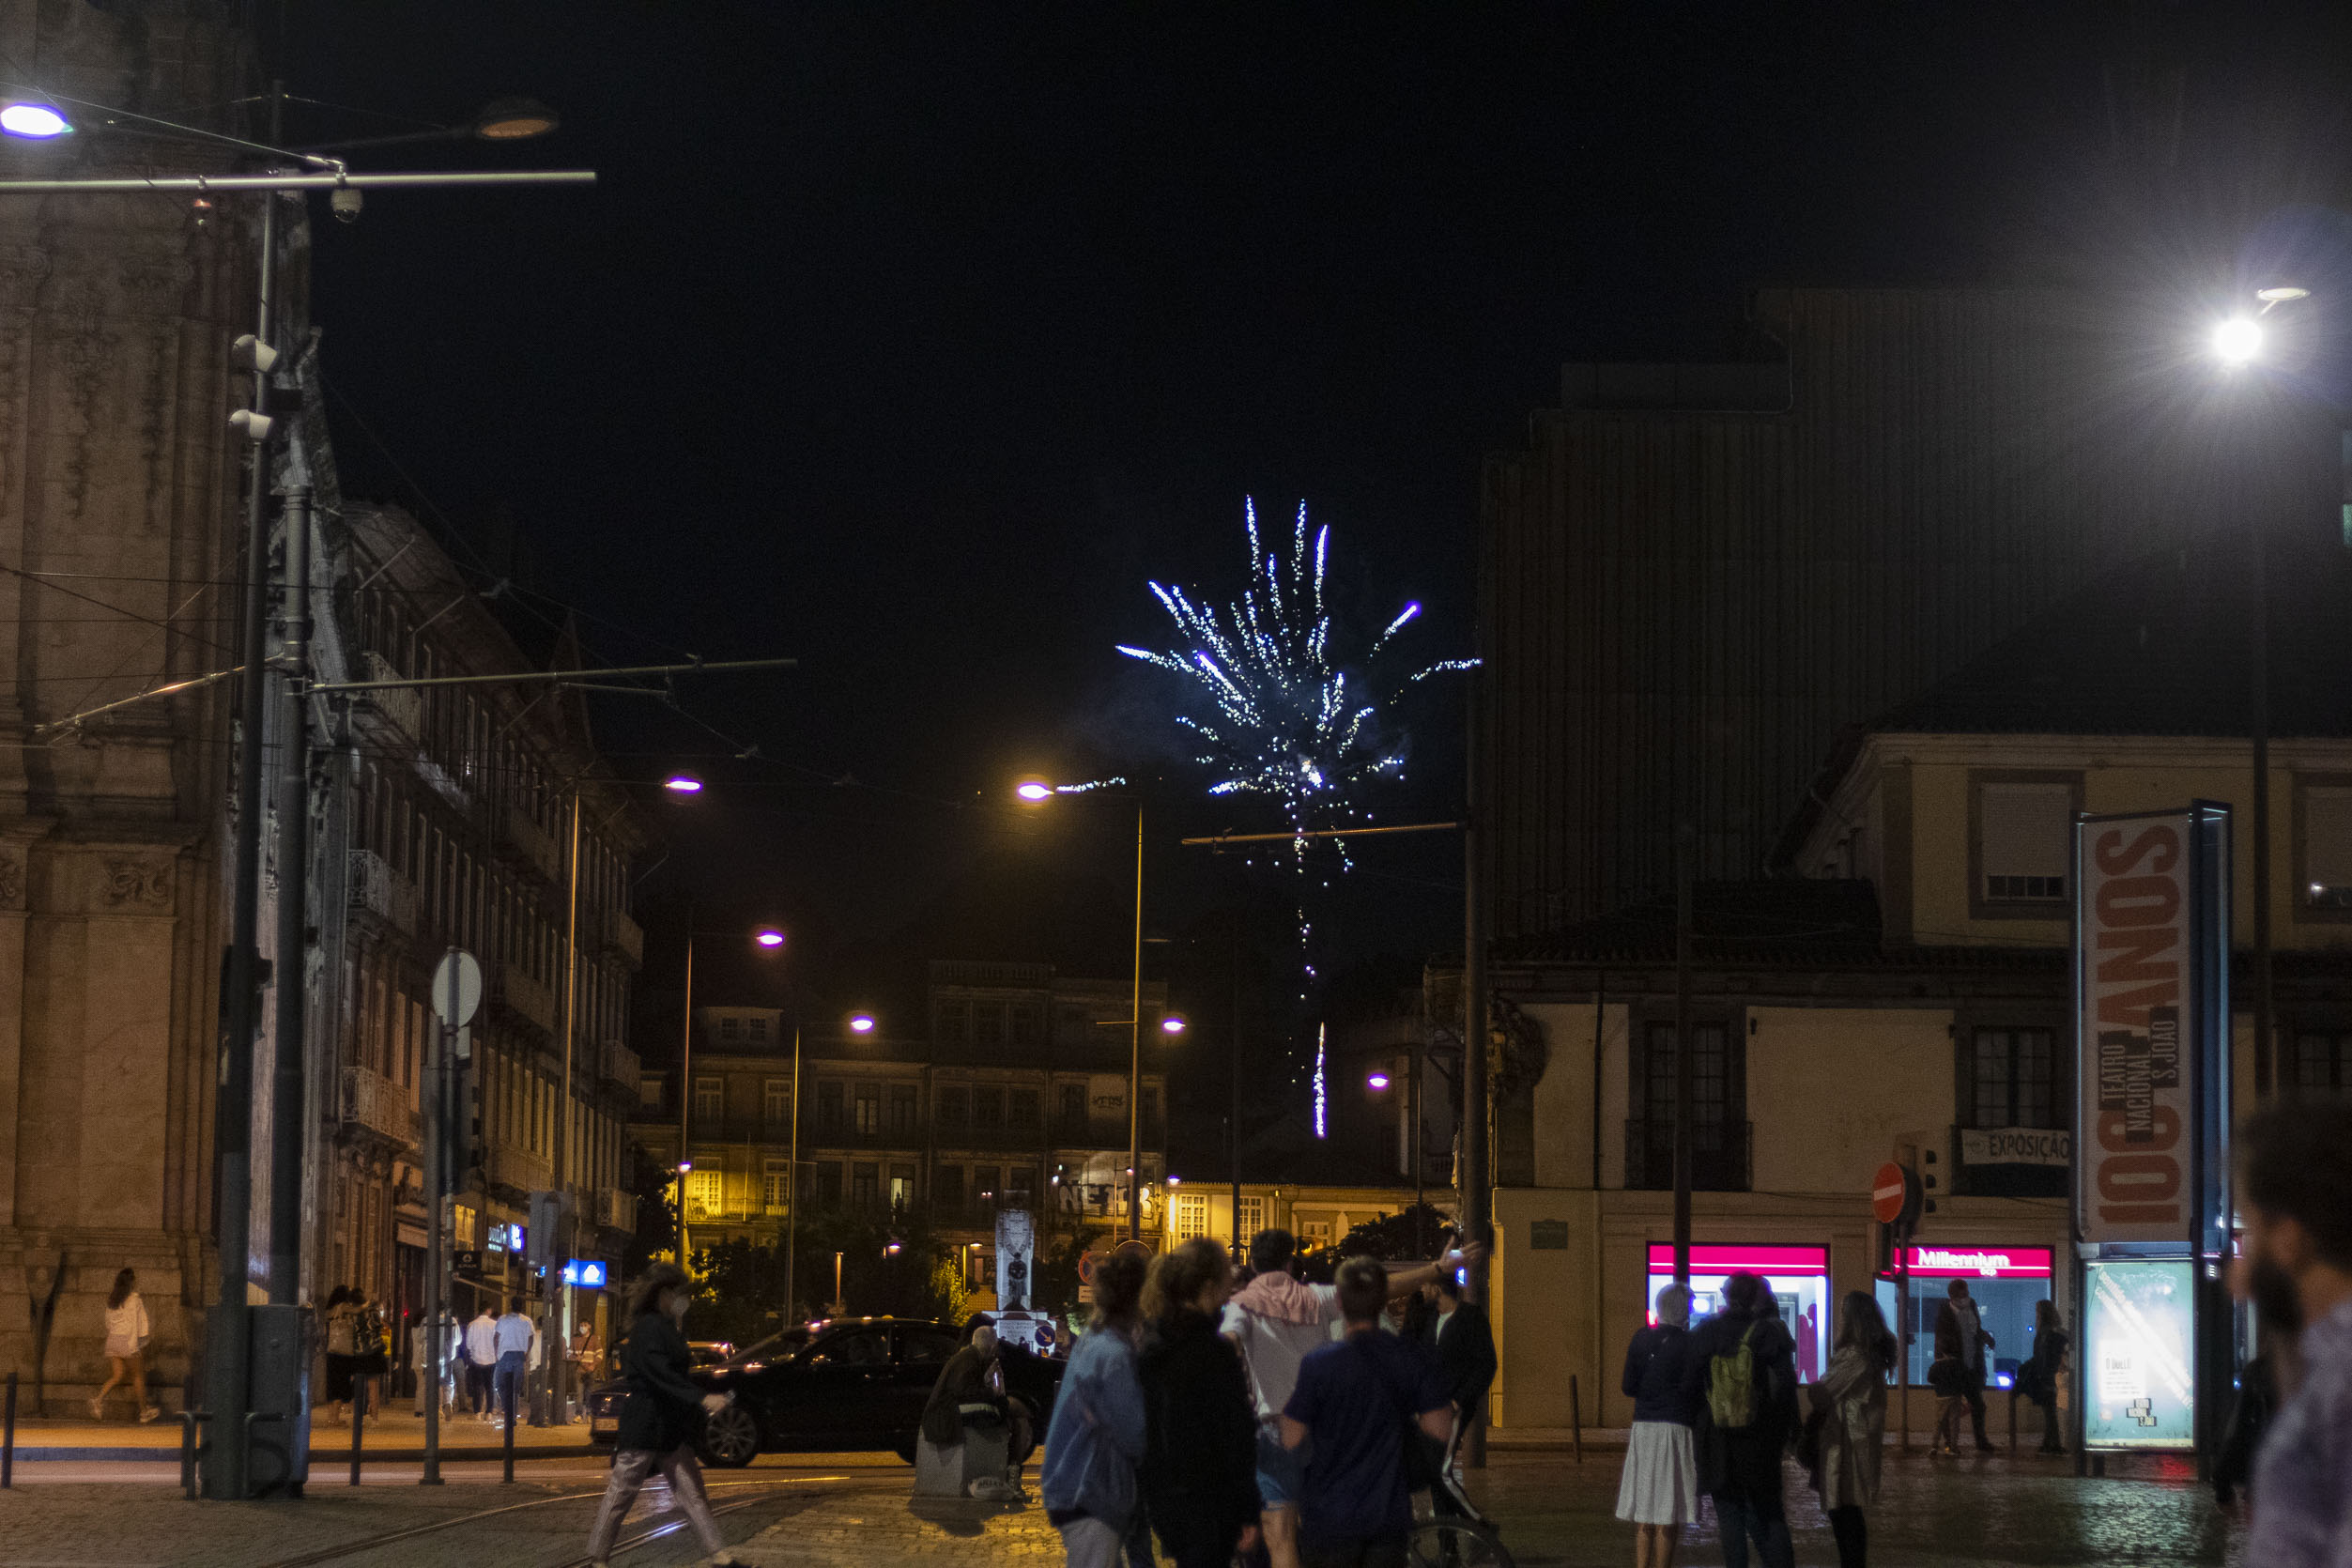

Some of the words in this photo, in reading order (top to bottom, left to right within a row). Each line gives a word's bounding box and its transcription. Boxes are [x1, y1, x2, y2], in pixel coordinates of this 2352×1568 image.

[2095, 824, 2180, 1027] ANOS
[2100, 1044, 2127, 1102] TEATRO
[2126, 1051, 2152, 1131] NACIONAL
[1990, 1130, 2070, 1164] EXPOSIÇÃO
[1917, 1246, 2011, 1267] Millennium
